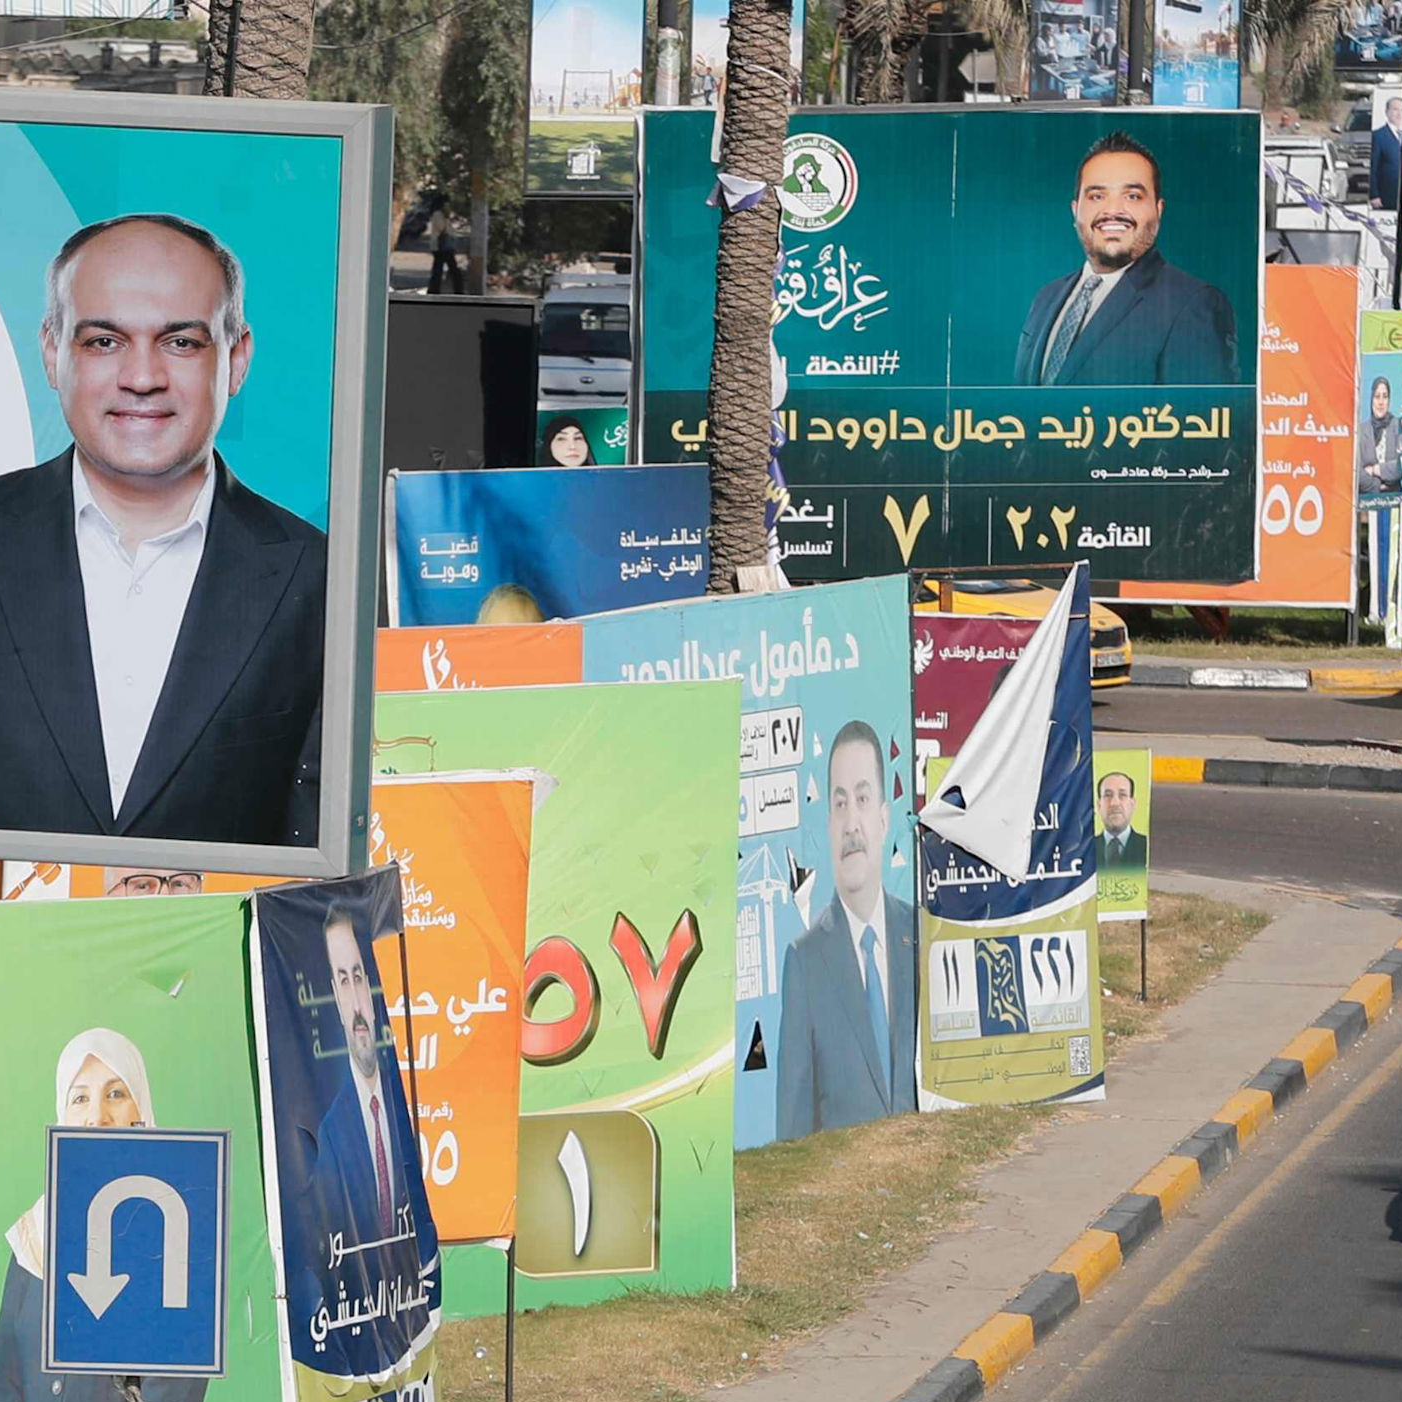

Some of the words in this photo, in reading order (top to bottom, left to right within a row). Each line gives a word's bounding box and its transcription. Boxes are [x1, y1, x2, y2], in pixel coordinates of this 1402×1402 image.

[806, 408, 929, 449] داوود
[931, 407, 1026, 453] جمال
[1038, 406, 1093, 450] زيد
[1102, 403, 1231, 449] الدكتور
[1293, 414, 1350, 443] سيف
[1188, 466, 1230, 480] مرشح
[1292, 459, 1316, 479] رقم
[419, 536, 479, 558] قضية
[620, 529, 660, 549] سيادة
[660, 527, 703, 546] تحالف
[883, 494, 931, 567] ٧
[1005, 504, 1077, 552] ٢٠٢
[1077, 525, 1151, 548] القائمة
[419, 561, 480, 583] وهوية
[771, 715, 801, 756] ٢٠٧
[942, 943, 960, 1007] ١١
[1030, 936, 1075, 999] ٢٢١
[446, 976, 509, 1037] علي
[430, 1100, 454, 1123] رقم
[555, 1127, 591, 1259] ١
